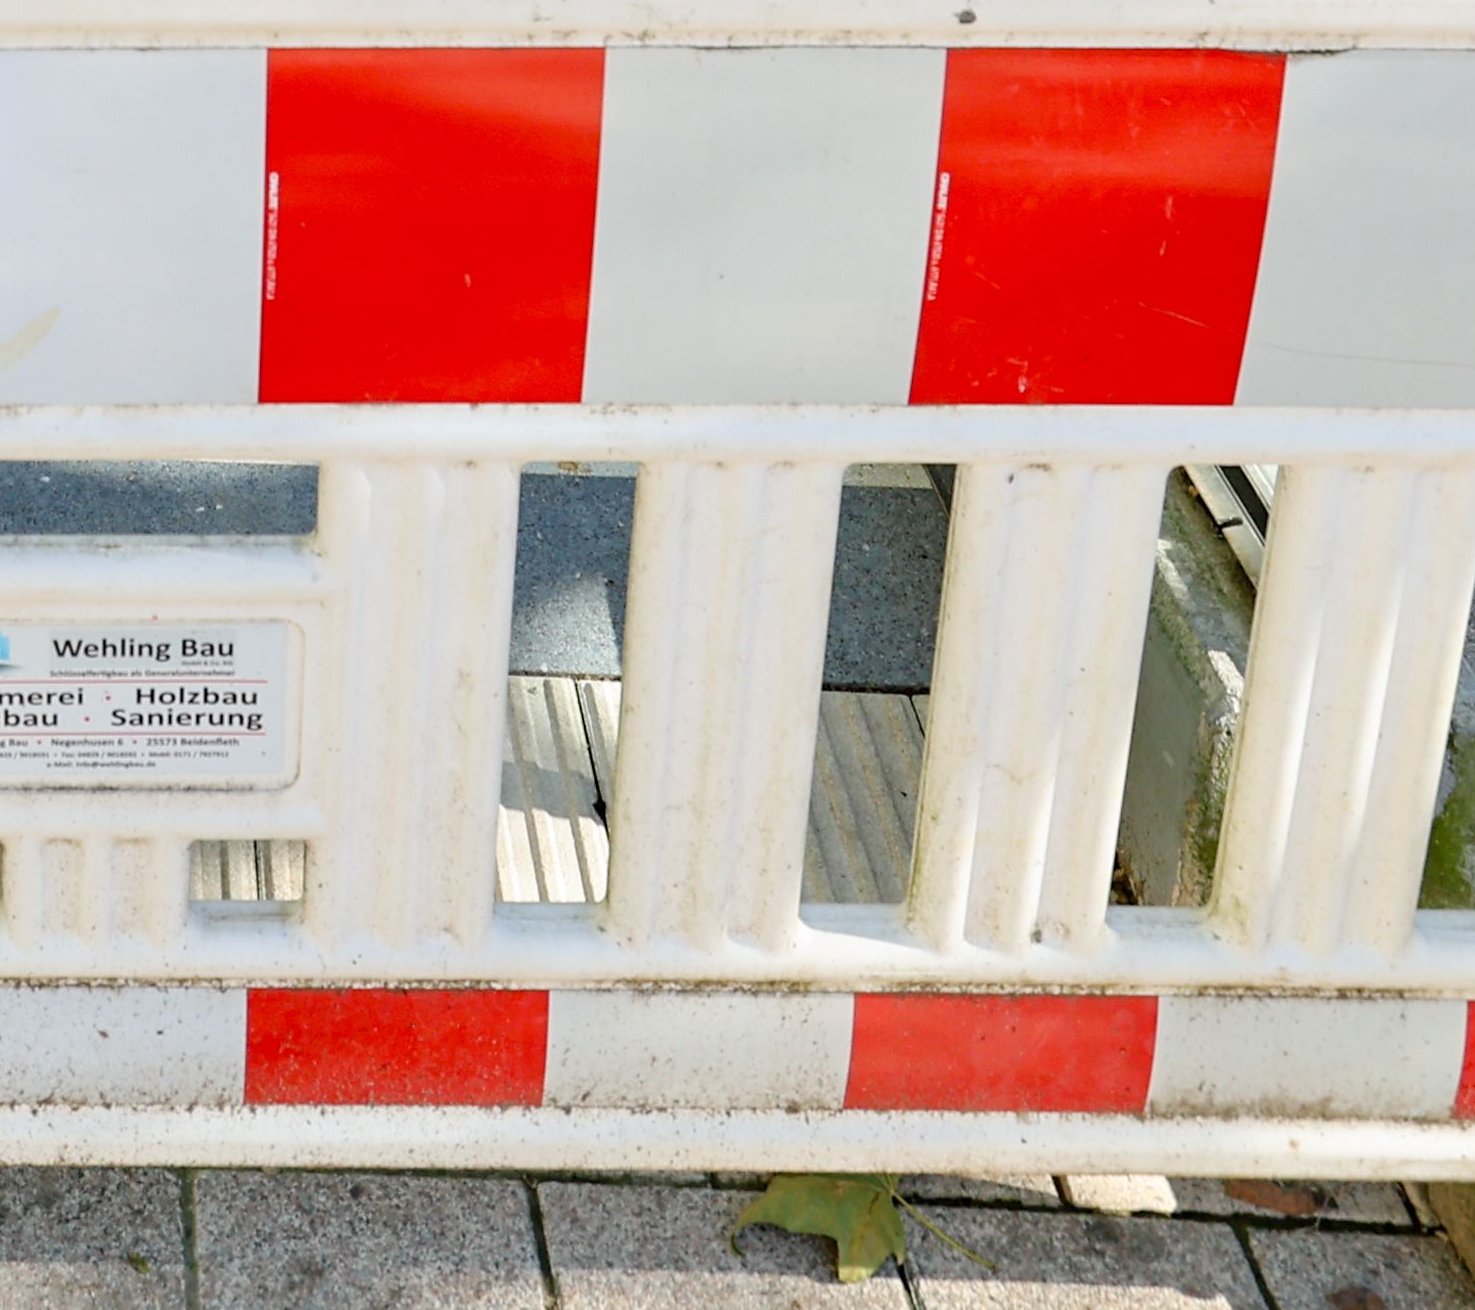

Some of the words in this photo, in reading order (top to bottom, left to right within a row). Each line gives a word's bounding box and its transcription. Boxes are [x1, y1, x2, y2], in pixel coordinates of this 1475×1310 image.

[53, 638, 171, 661] Wehling
[181, 638, 234, 658] Bau
[135, 687, 258, 706] Holzbau
[110, 708, 264, 731] Sanierung
[8, 738, 28, 747] Bau
[50, 738, 115, 748] Negenhusen
[117, 738, 124, 747] 6
[145, 738, 178, 747] 25573
[179, 737, 240, 747] Beidenfleth
